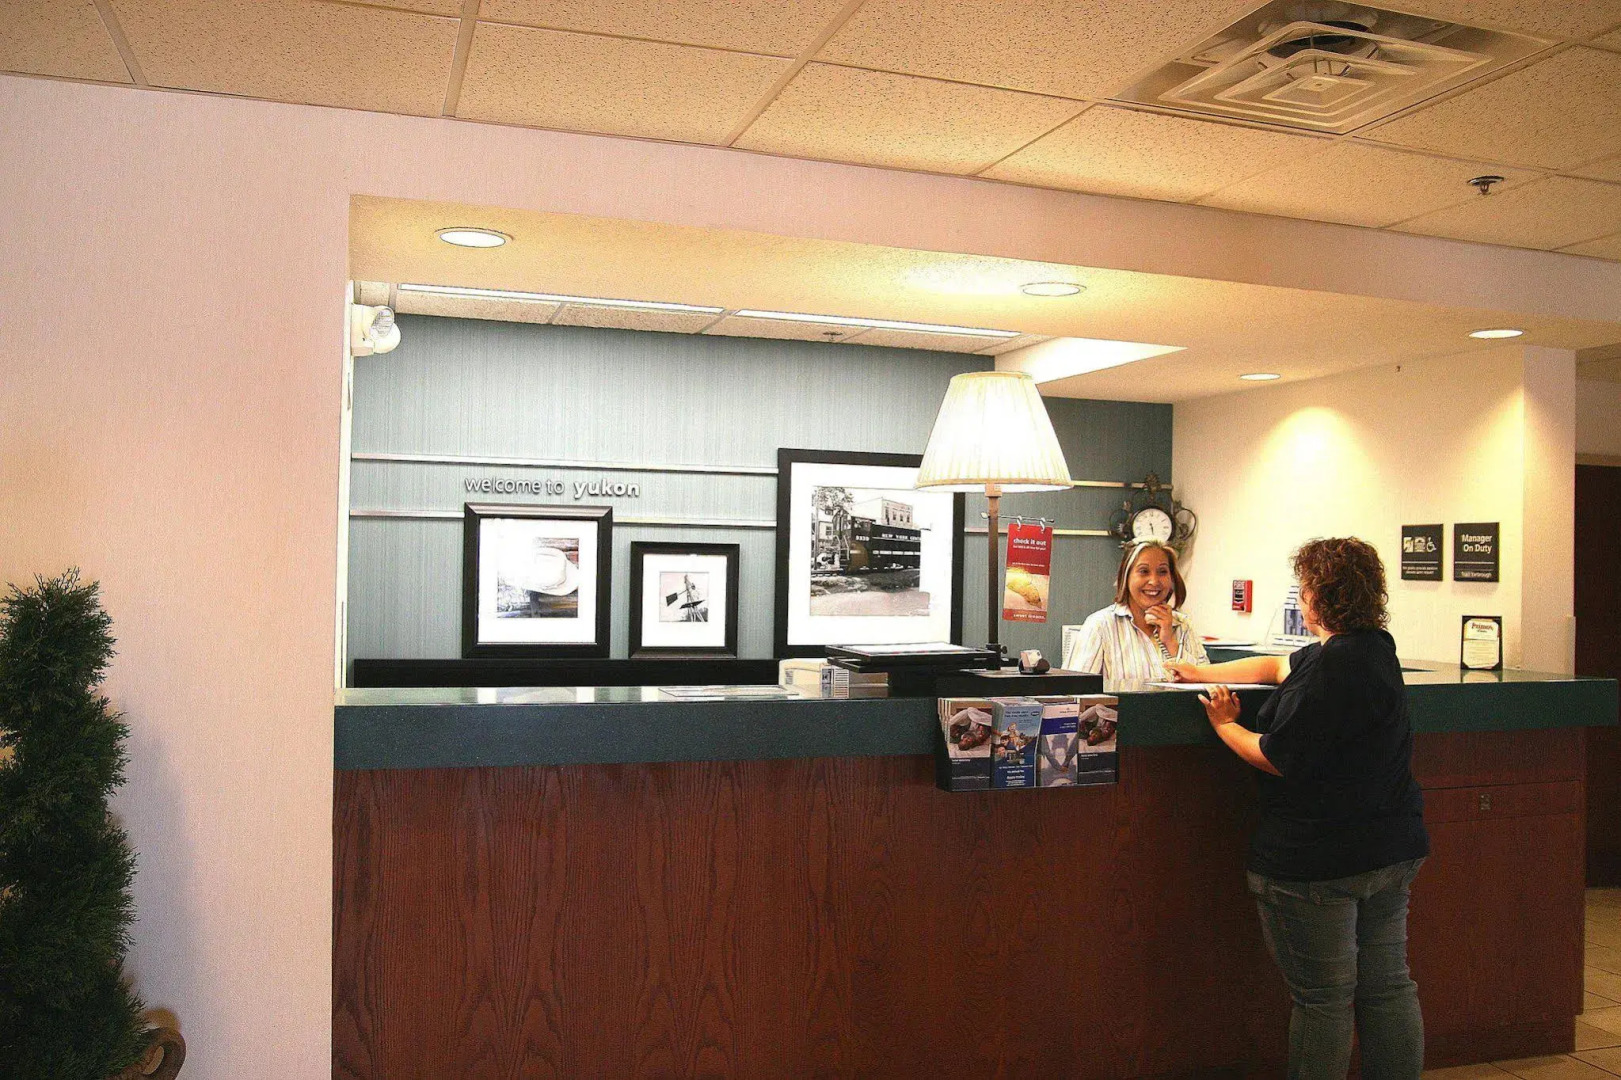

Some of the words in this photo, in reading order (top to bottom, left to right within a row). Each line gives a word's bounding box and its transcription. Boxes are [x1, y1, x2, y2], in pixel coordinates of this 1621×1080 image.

[465, 477, 541, 495] welcome
[546, 479, 565, 495] to
[574, 479, 641, 499] yukon
[1013, 537, 1030, 545] check
[1461, 534, 1492, 544] Manager
[1463, 544, 1473, 552] On
[1475, 544, 1492, 554] Duty
